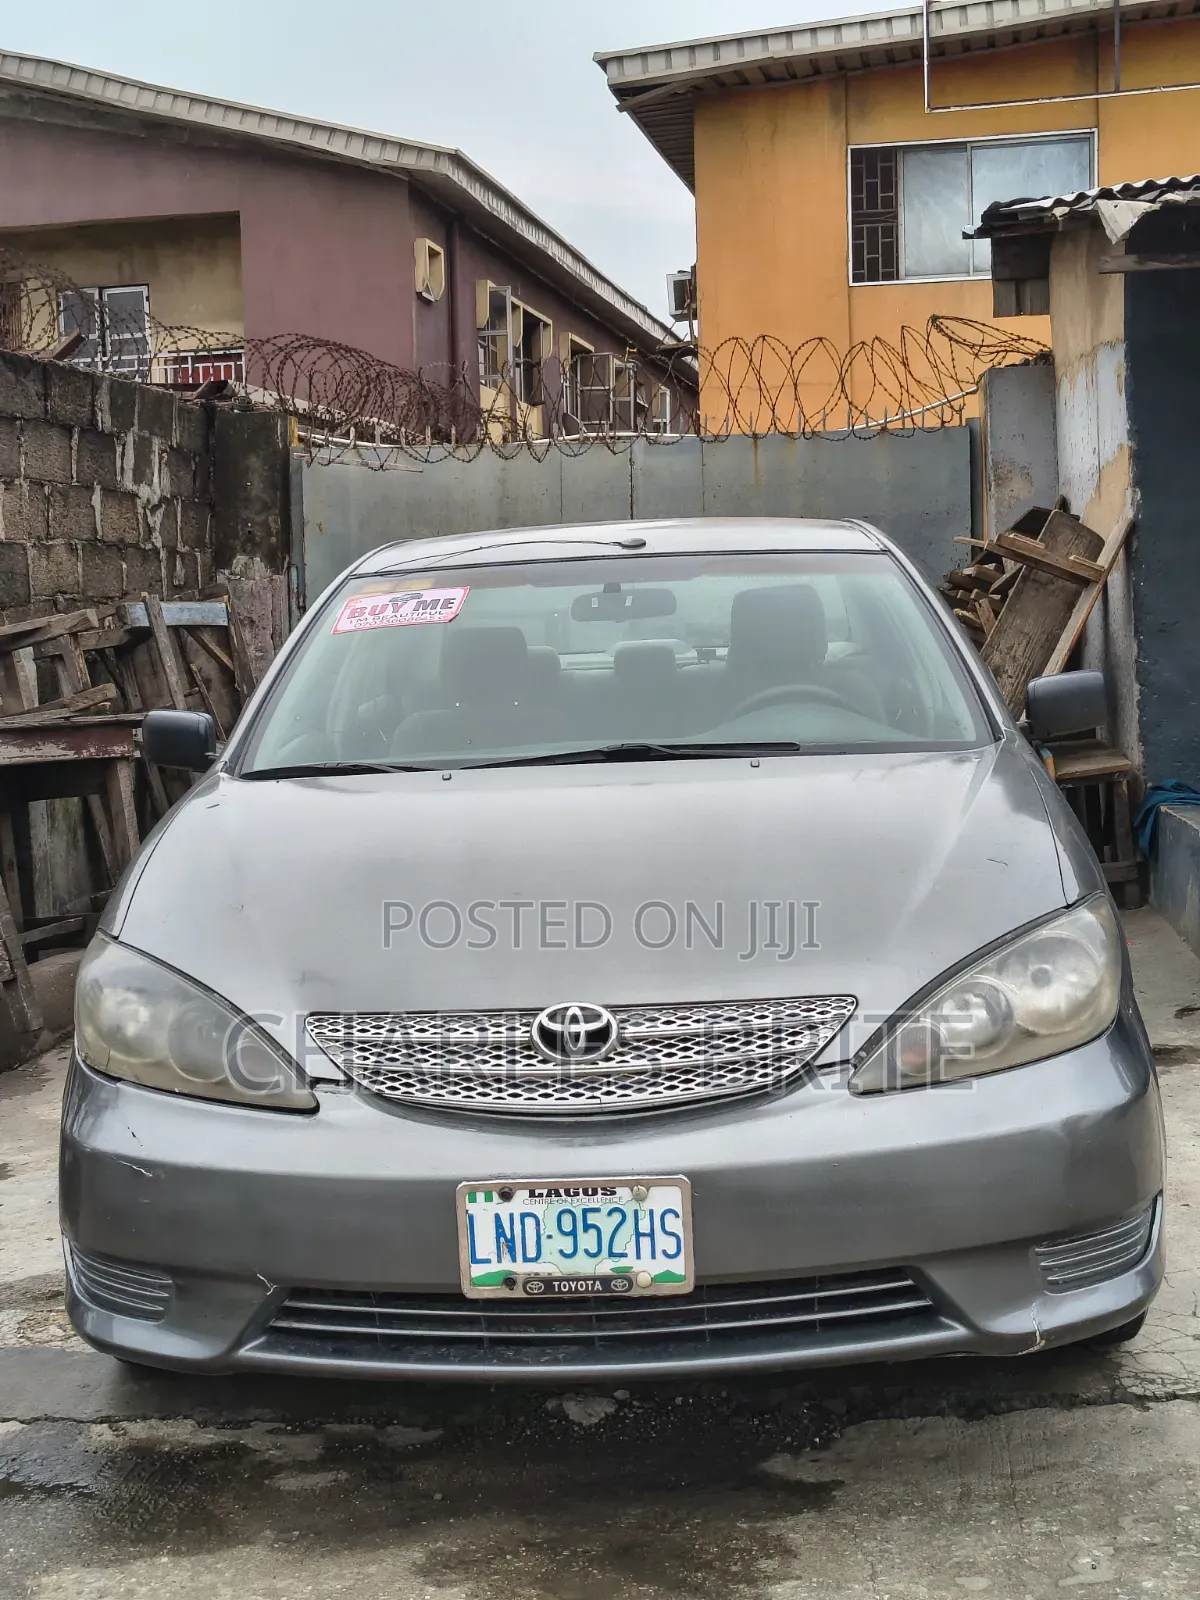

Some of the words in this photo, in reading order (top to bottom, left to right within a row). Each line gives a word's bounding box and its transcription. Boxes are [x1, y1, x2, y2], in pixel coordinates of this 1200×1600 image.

[347, 603, 407, 619] BUY
[413, 598, 456, 611] ME
[372, 611, 444, 621] BEAUTIFUL
[528, 1187, 617, 1198] LAGOS
[571, 1196, 623, 1204] EXCELLENCE
[552, 1280, 603, 1292] TOYOTA
